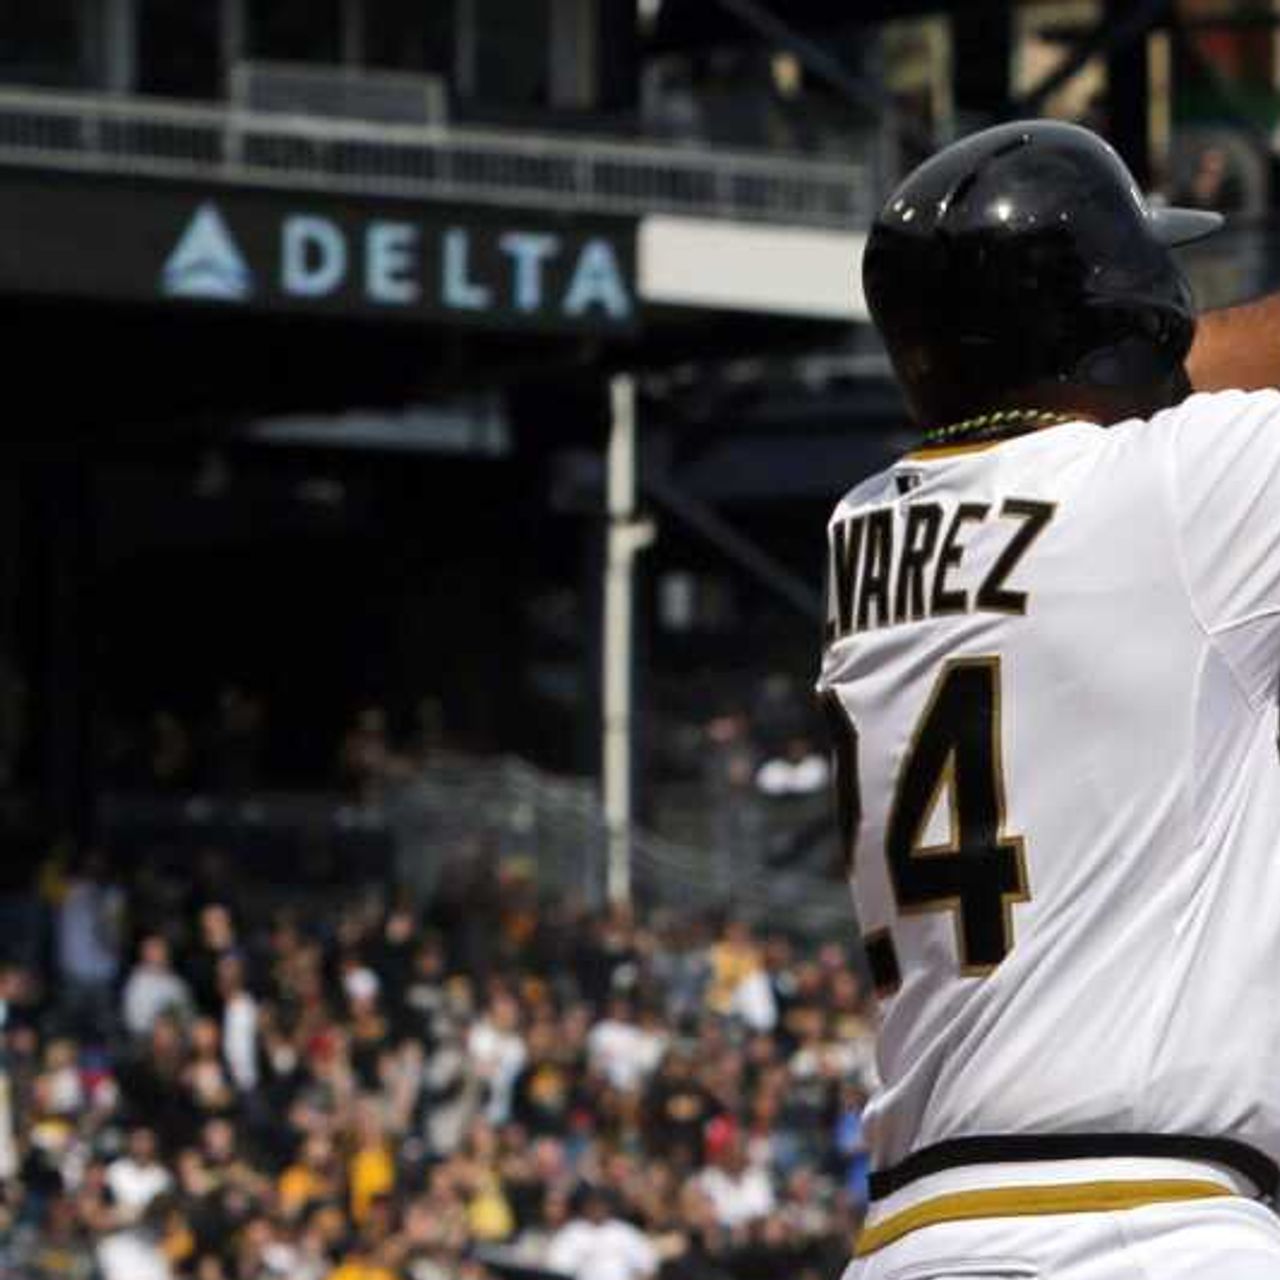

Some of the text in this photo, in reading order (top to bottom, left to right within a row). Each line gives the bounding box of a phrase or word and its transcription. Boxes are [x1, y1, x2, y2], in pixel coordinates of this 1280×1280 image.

[280, 213, 633, 320] DELTA
[826, 498, 1058, 645] VAREZ
[836, 655, 1032, 994] 4
